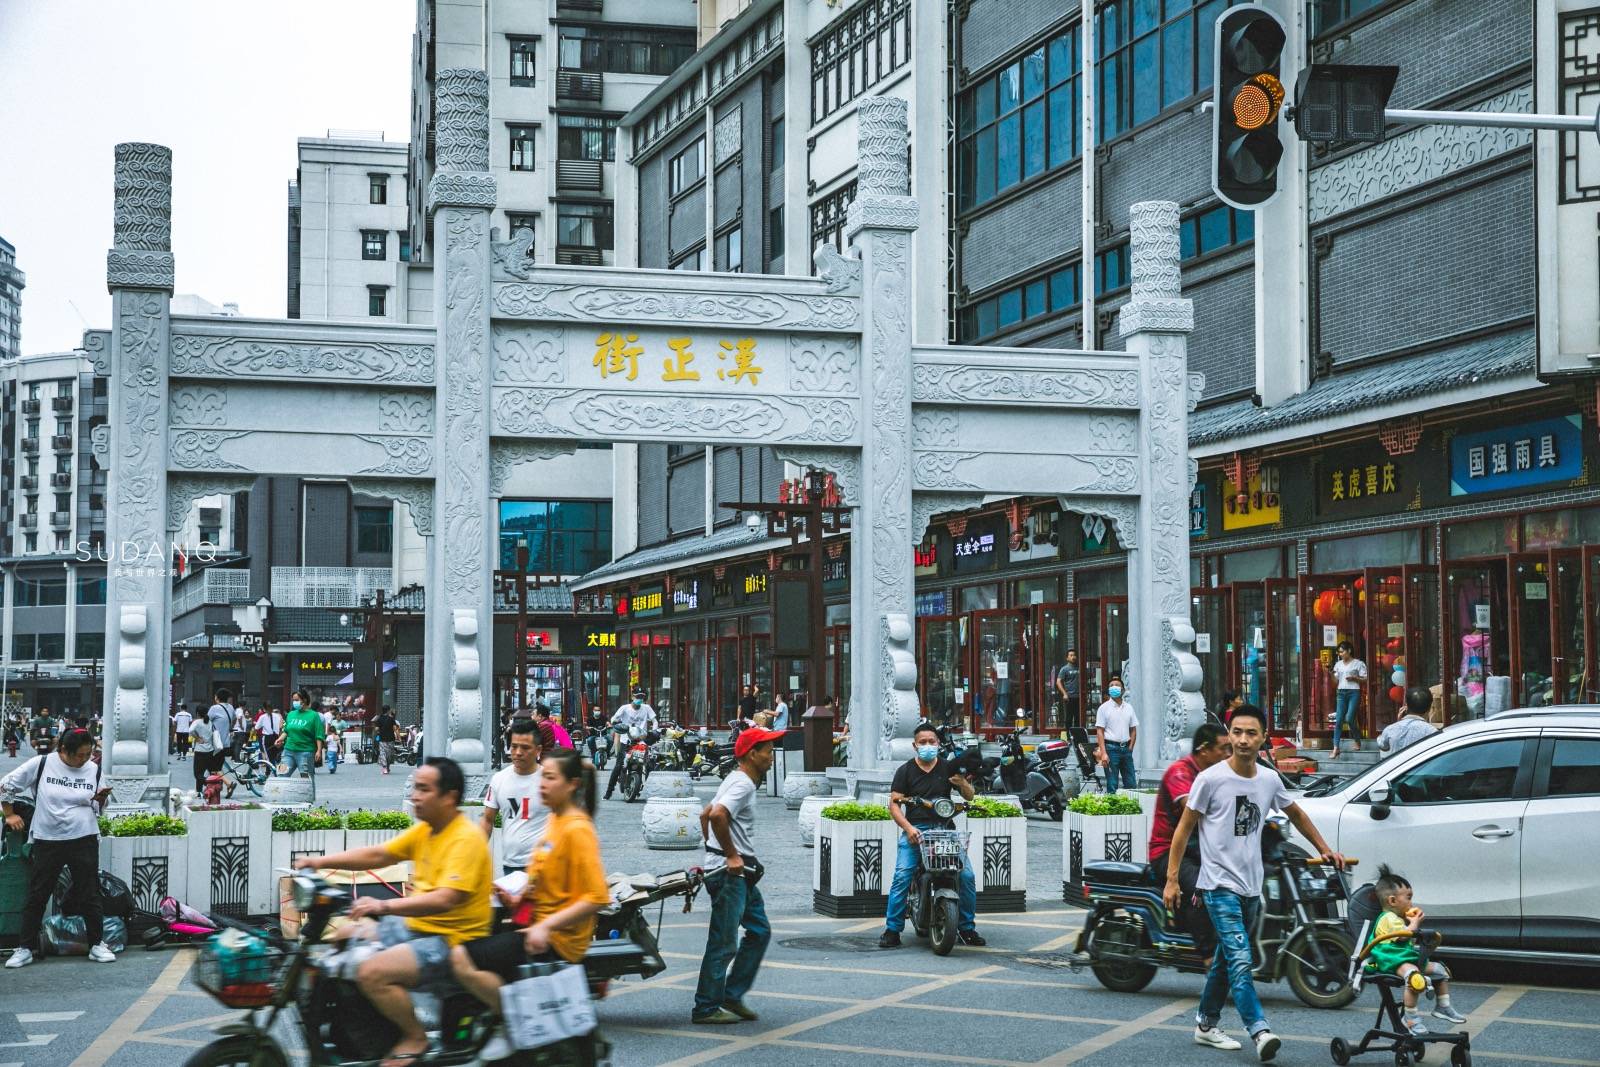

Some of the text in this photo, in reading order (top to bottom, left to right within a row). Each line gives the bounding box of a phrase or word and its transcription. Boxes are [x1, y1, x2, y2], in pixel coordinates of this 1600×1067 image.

[1468, 434, 1556, 479] 国强雨具
[1332, 461, 1395, 500] 英虎喜庆
[955, 537, 980, 556] 天堂伞
